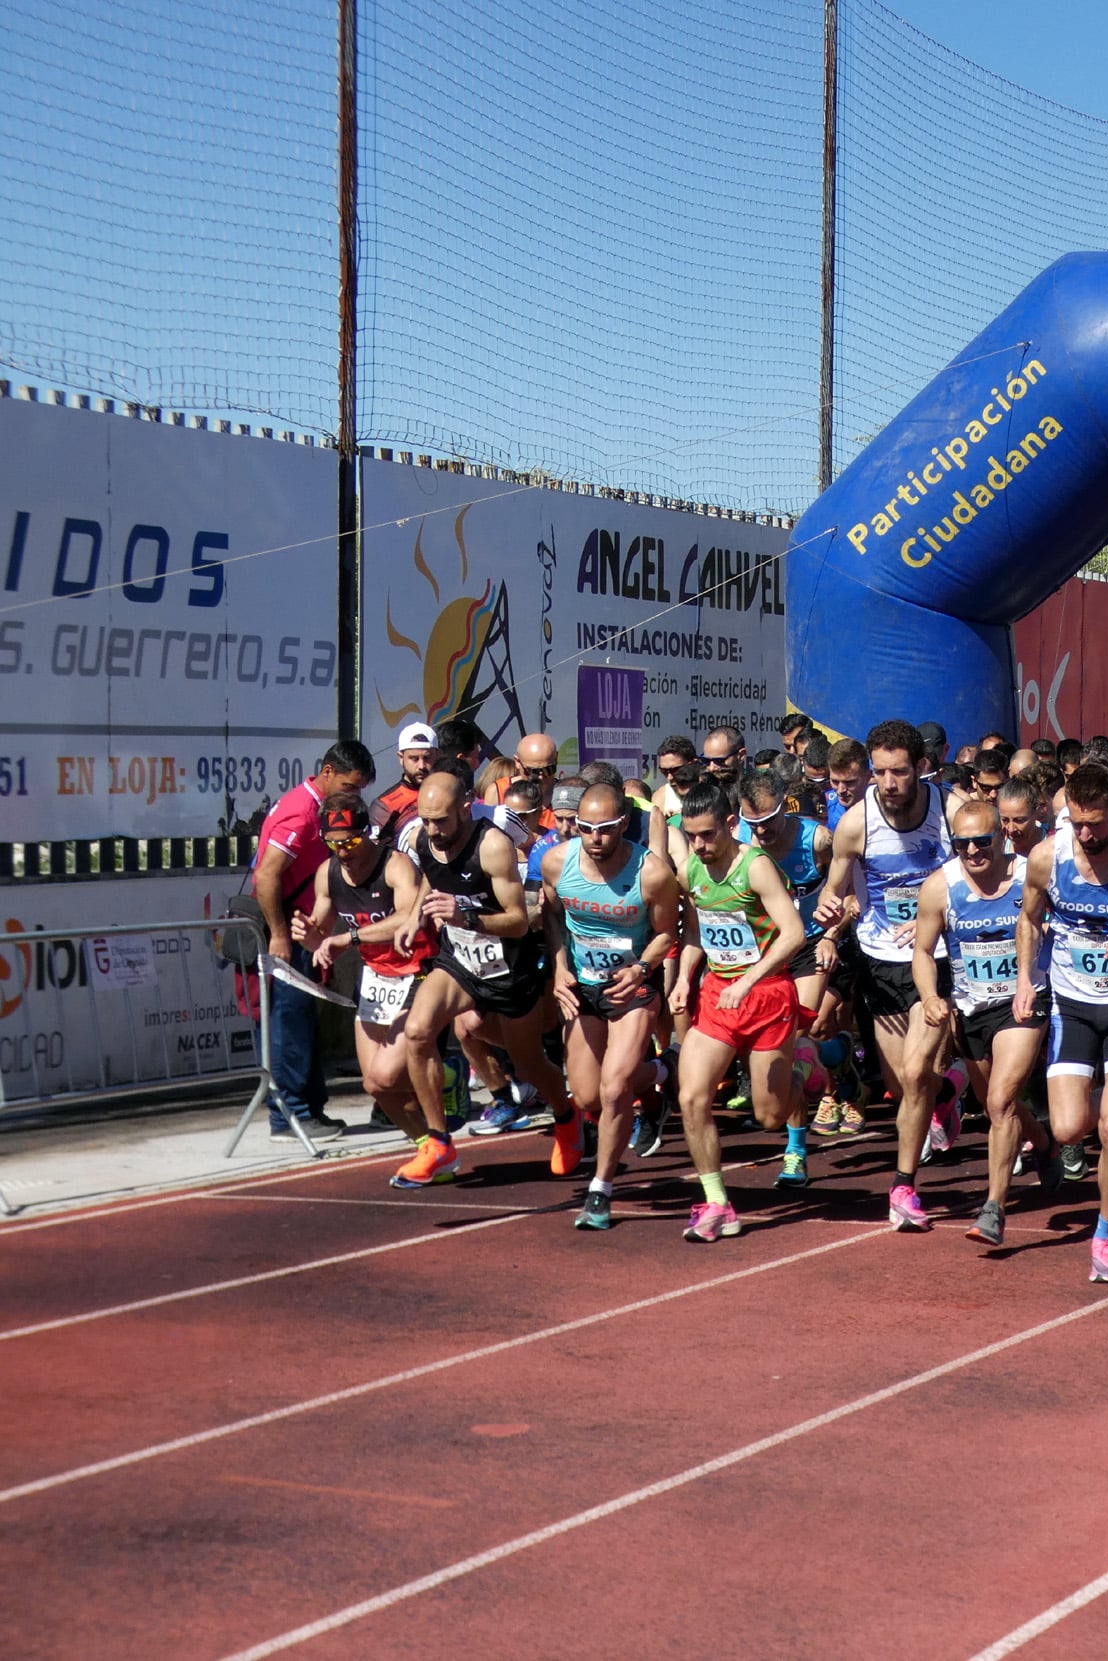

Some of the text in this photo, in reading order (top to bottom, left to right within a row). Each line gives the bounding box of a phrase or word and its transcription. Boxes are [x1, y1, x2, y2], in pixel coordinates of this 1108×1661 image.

[847, 360, 1046, 555] Participación
[899, 415, 1063, 568] Ciudadana
[577, 528, 672, 602] ANGEL
[577, 622, 743, 663] INSTALACIONES DE:
[597, 671, 632, 720] LOJA
[643, 670, 767, 700] ación Electricidad
[643, 706, 661, 730] ón
[689, 708, 746, 732] Energías
[586, 731, 594, 744] NO
[57, 756, 94, 795] EN
[109, 757, 187, 805] LOJA:
[197, 757, 267, 795] 95833
[1059, 901, 1094, 912] TODO
[959, 915, 1019, 930] TODO SUM
[706, 927, 744, 948] 230
[585, 950, 625, 969] 139
[367, 985, 405, 1005] 3062
